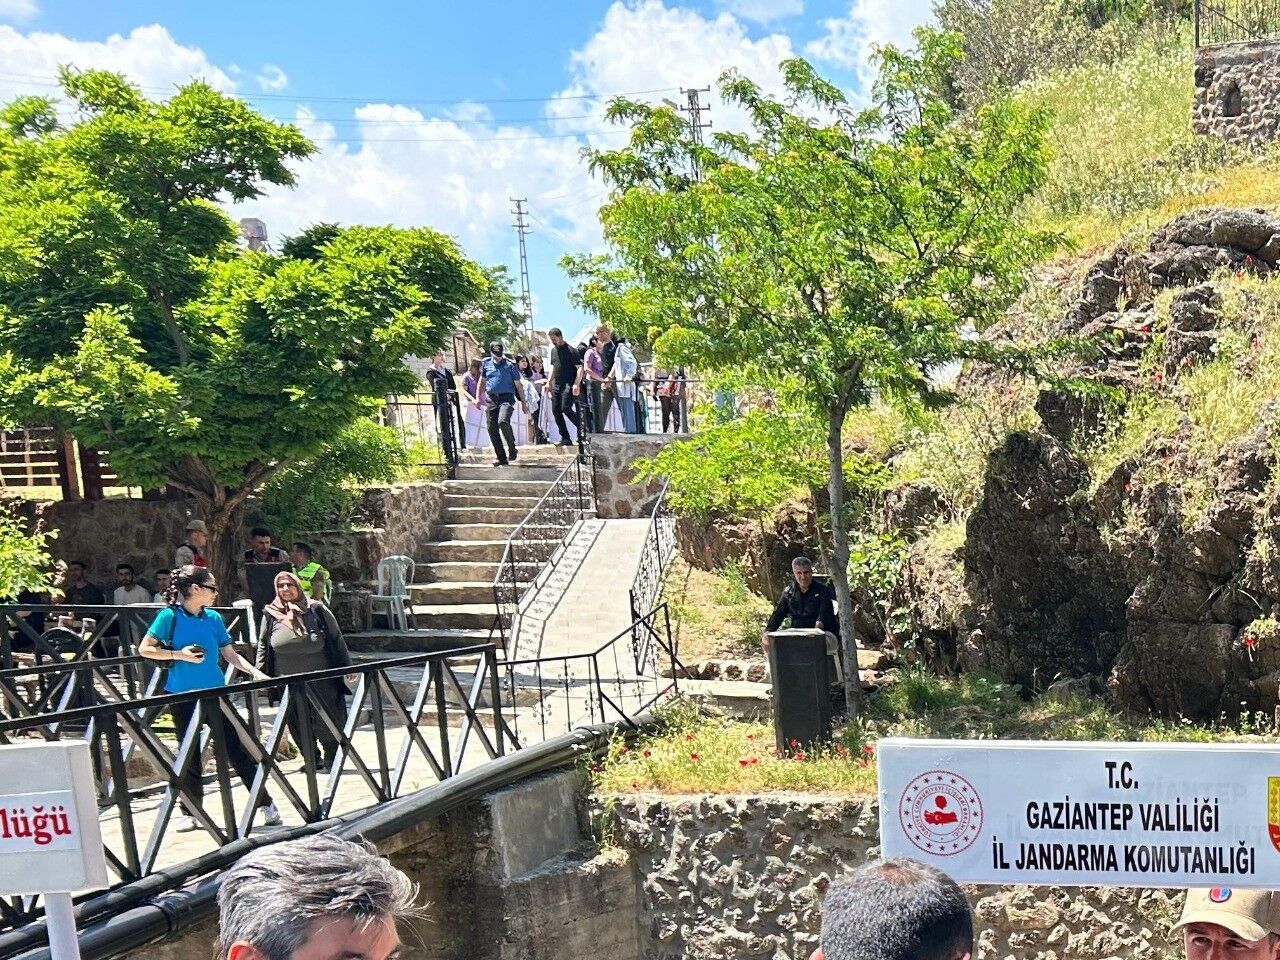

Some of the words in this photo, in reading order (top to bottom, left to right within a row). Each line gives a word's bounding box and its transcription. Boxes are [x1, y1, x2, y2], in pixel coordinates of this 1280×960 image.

[1105, 760, 1139, 790] T.C.
[0, 805, 71, 845] lüğü
[1026, 795, 1134, 831] GAZİANTEP
[1139, 797, 1220, 832] VALİLİĞİ
[992, 836, 1009, 870] İL
[1015, 843, 1118, 873] JANDARMA
[1124, 840, 1256, 875] KOMUTANLIĞI
